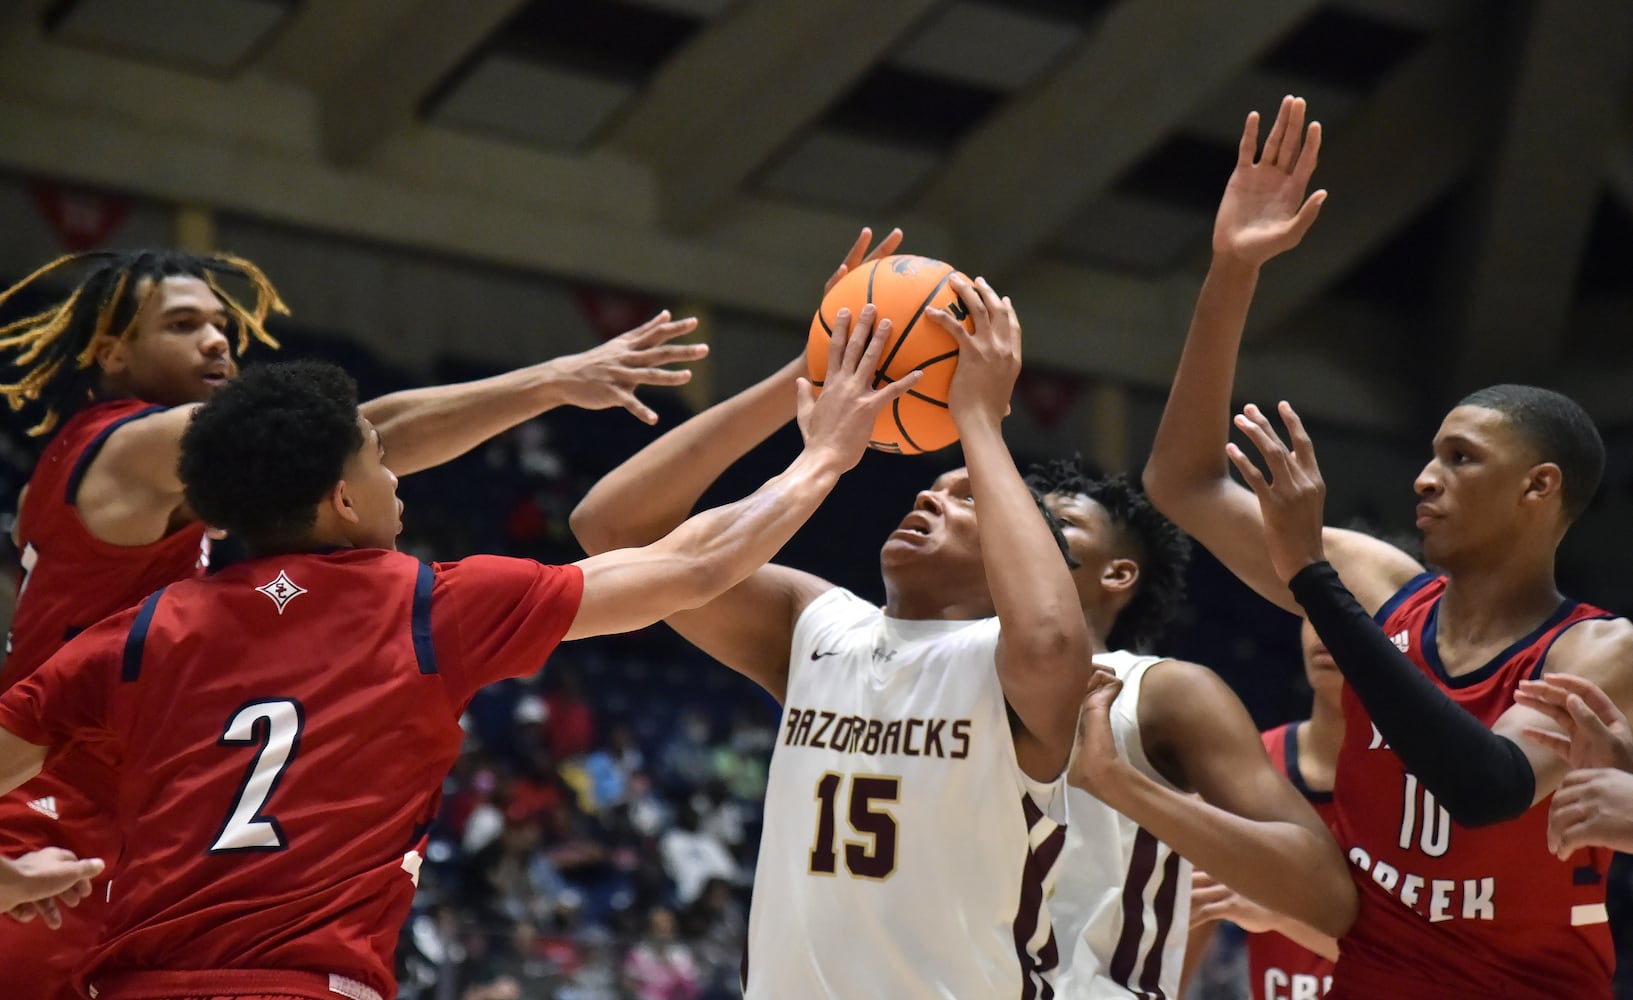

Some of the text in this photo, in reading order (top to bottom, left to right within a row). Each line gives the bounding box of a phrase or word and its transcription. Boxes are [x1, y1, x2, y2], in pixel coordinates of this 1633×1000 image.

[208, 697, 305, 854] 2
[784, 707, 972, 760] RAZORBACKS
[807, 769, 903, 883] 15
